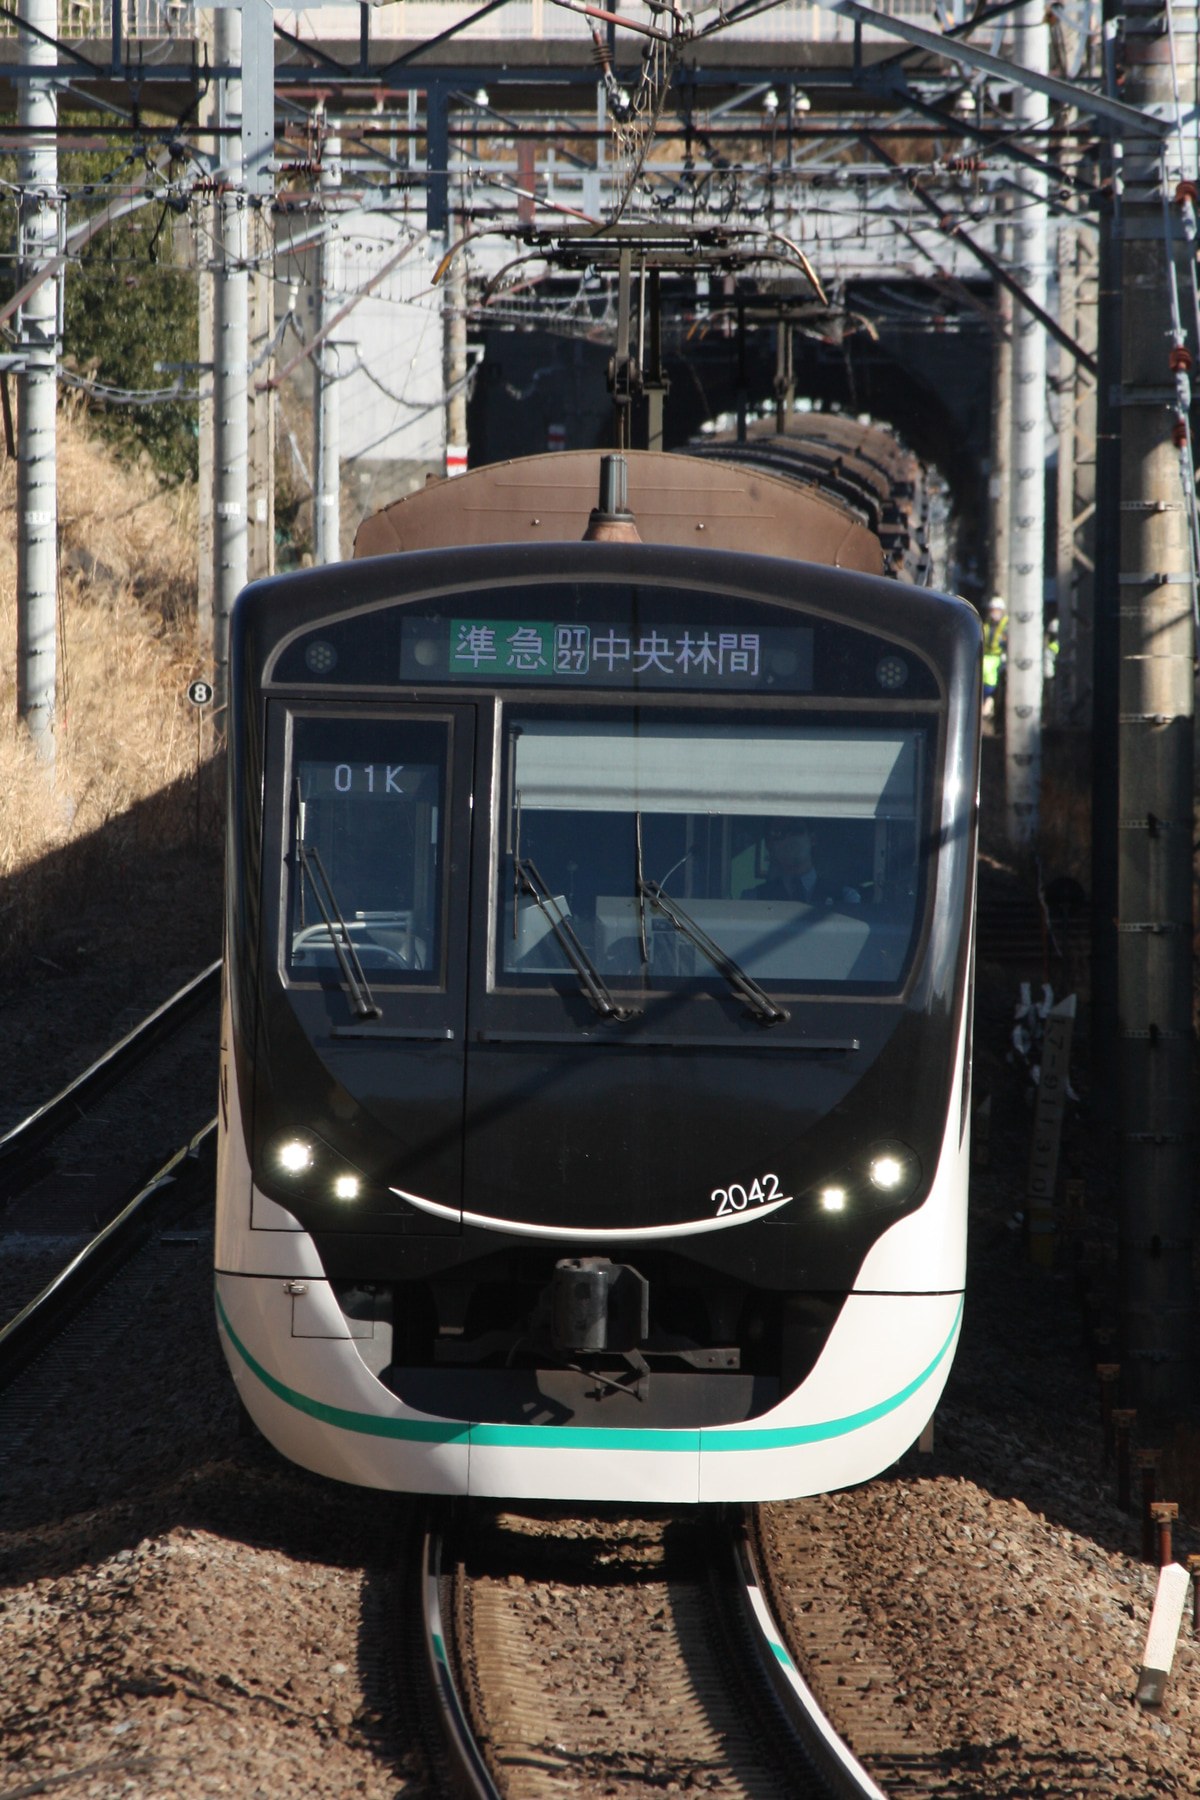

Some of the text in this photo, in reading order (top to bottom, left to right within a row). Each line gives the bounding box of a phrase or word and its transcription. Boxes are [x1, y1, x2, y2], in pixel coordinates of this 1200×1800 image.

[455, 625, 547, 670] 準急
[558, 629, 586, 649] DT
[592, 629, 760, 676] 中央林間
[557, 650, 586, 670] 27
[194, 683, 207, 702] 8
[711, 1173, 784, 1217] 2042
